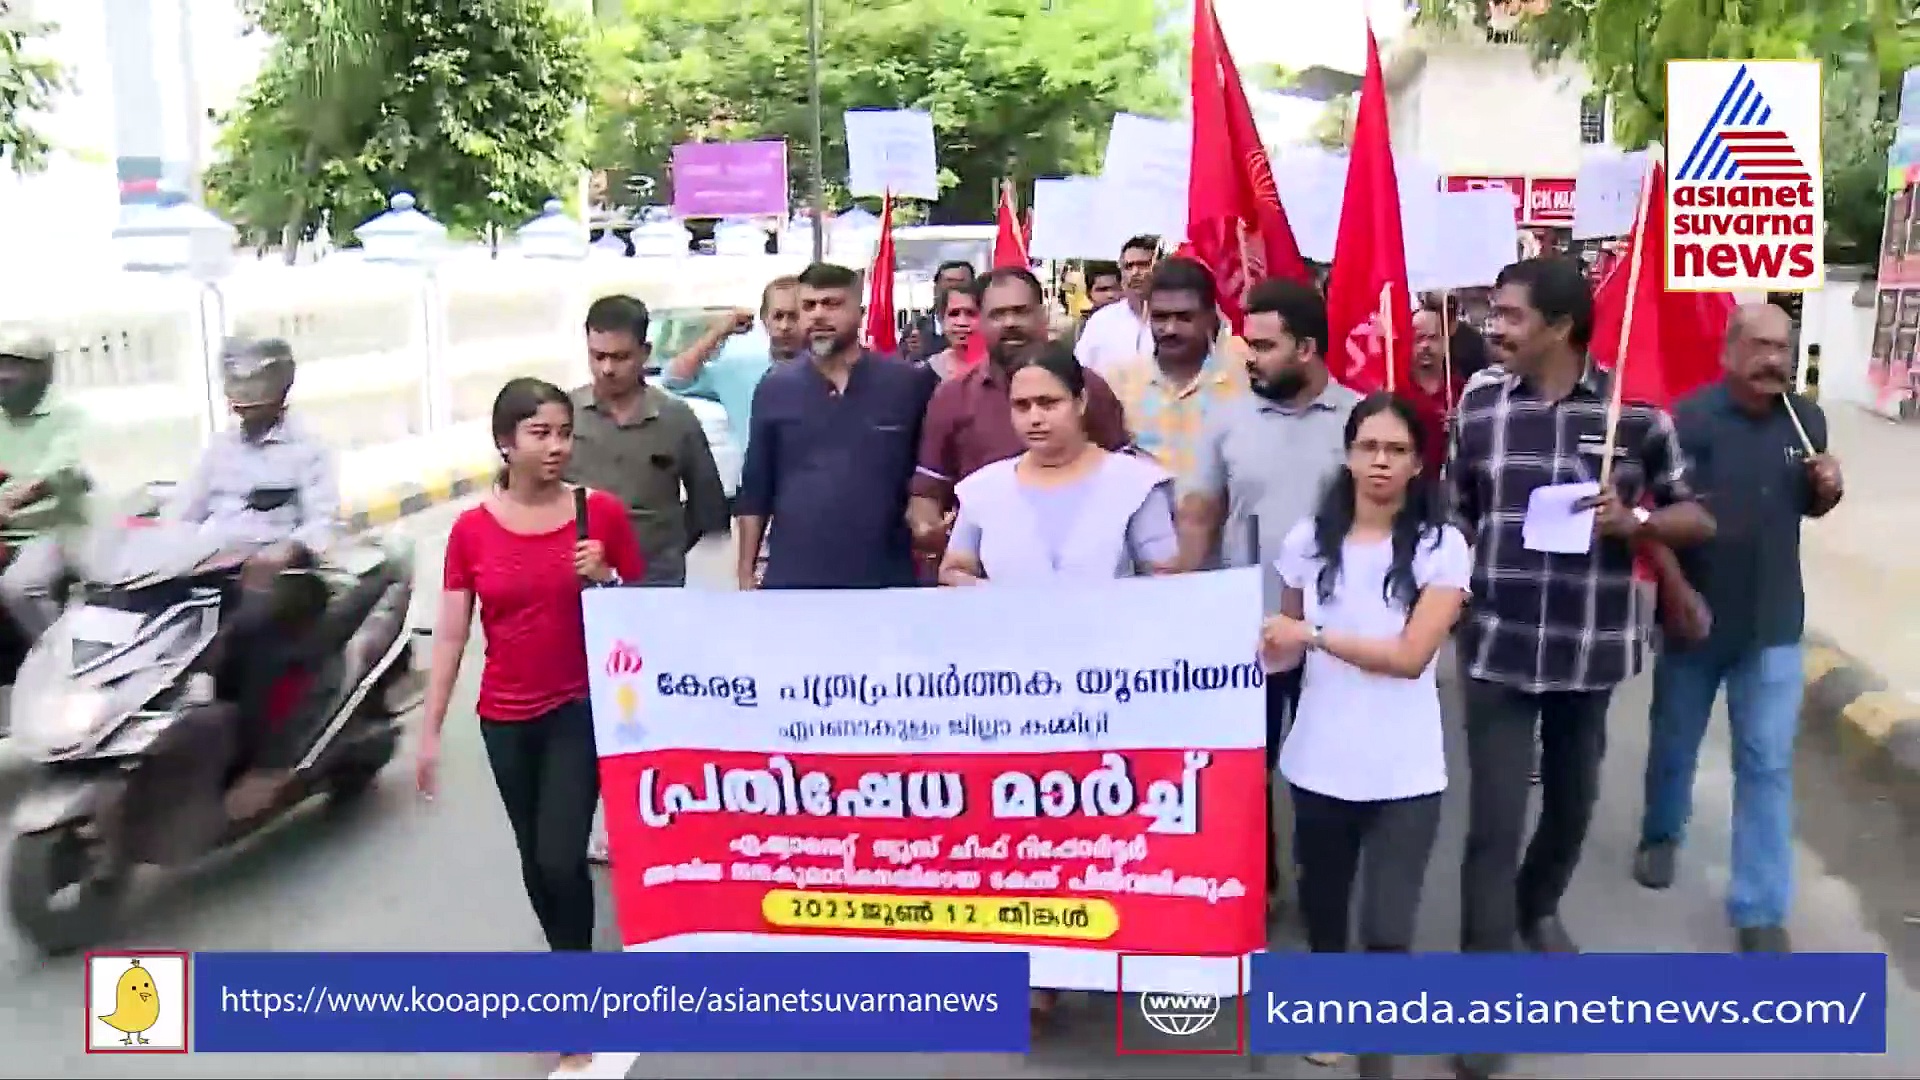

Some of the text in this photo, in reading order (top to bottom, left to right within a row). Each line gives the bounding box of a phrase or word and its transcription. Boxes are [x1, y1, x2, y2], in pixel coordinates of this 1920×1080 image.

[656, 671, 758, 707] കേരള
[639, 750, 1210, 833] പ്രതിഷേധ മാർച്ച്
